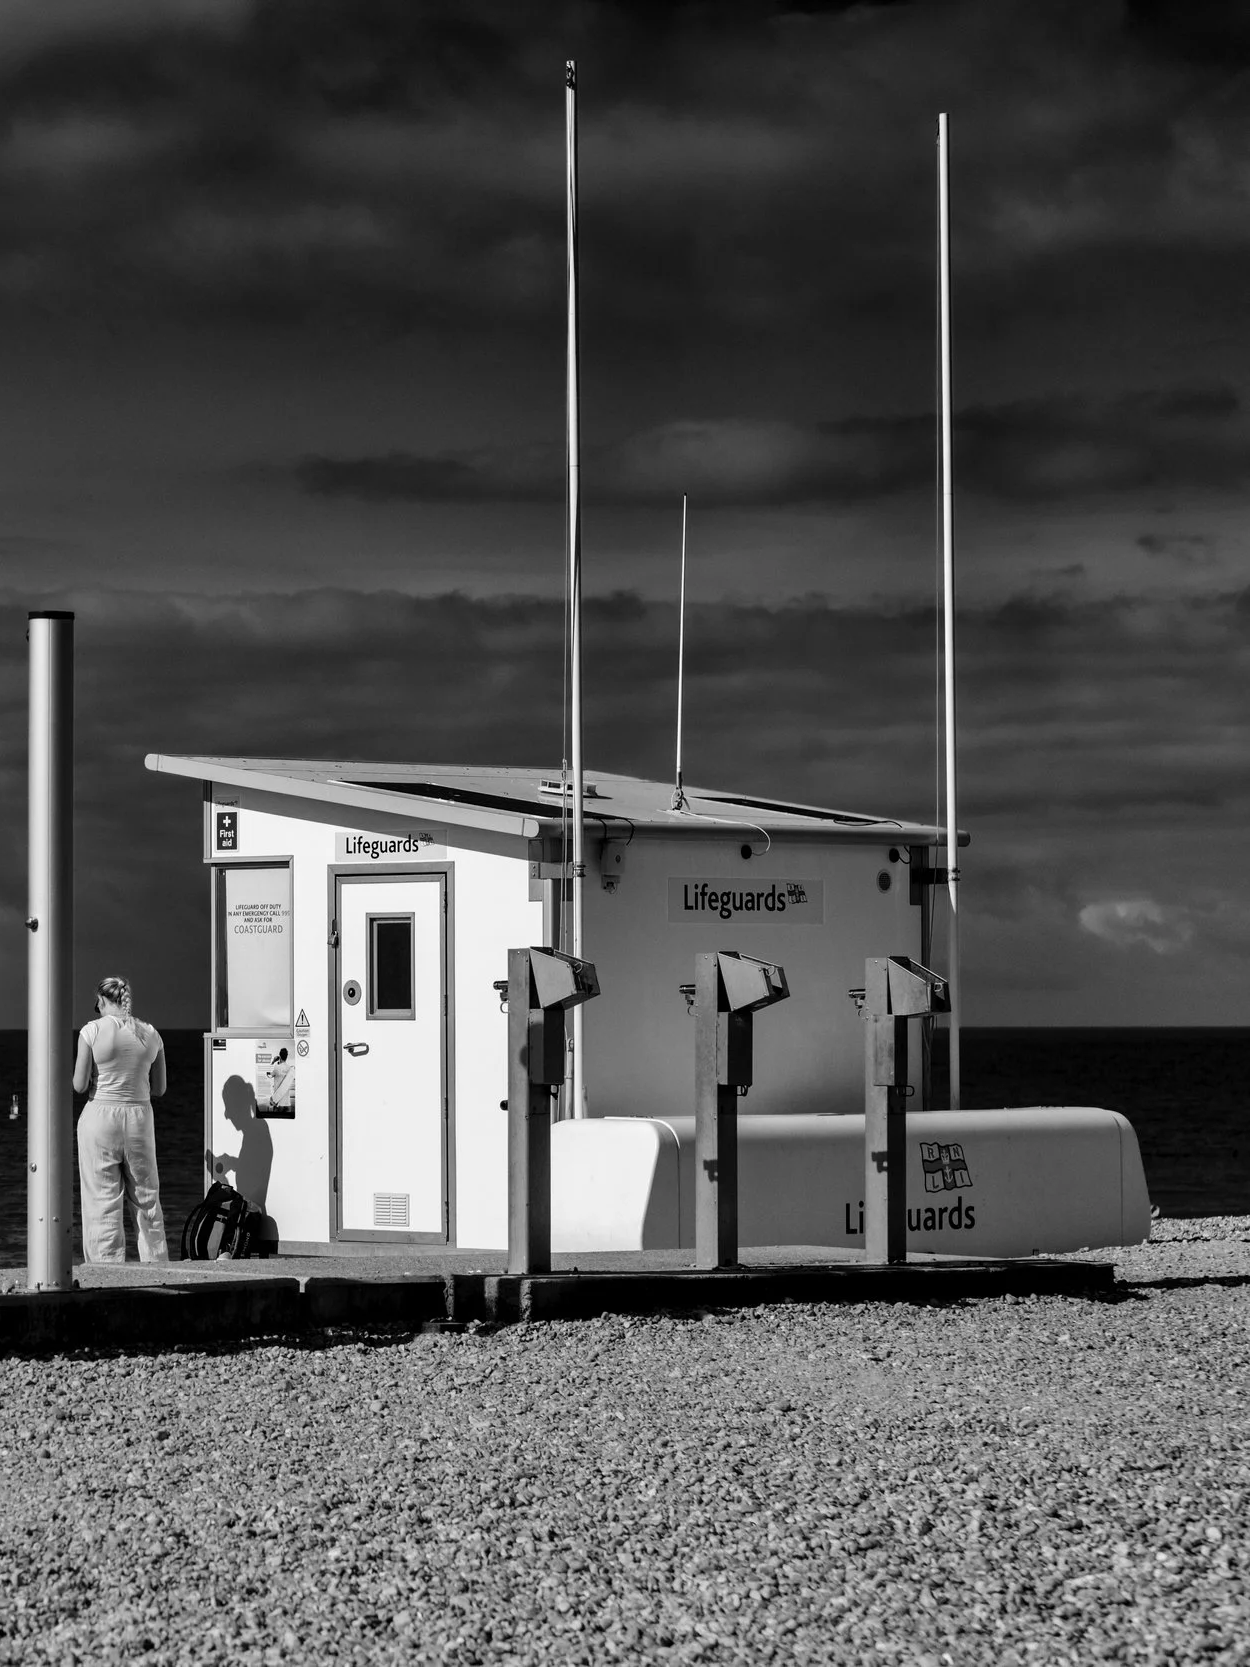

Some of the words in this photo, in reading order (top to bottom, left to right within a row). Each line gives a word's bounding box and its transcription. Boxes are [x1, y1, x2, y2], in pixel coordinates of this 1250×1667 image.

[219, 829, 234, 838] First
[222, 838, 233, 847] aid
[346, 834, 419, 859] Lifeguards
[683, 883, 786, 919] Lifeguards
[234, 924, 283, 934] COASTGUARD
[845, 1196, 976, 1235] Liuards
